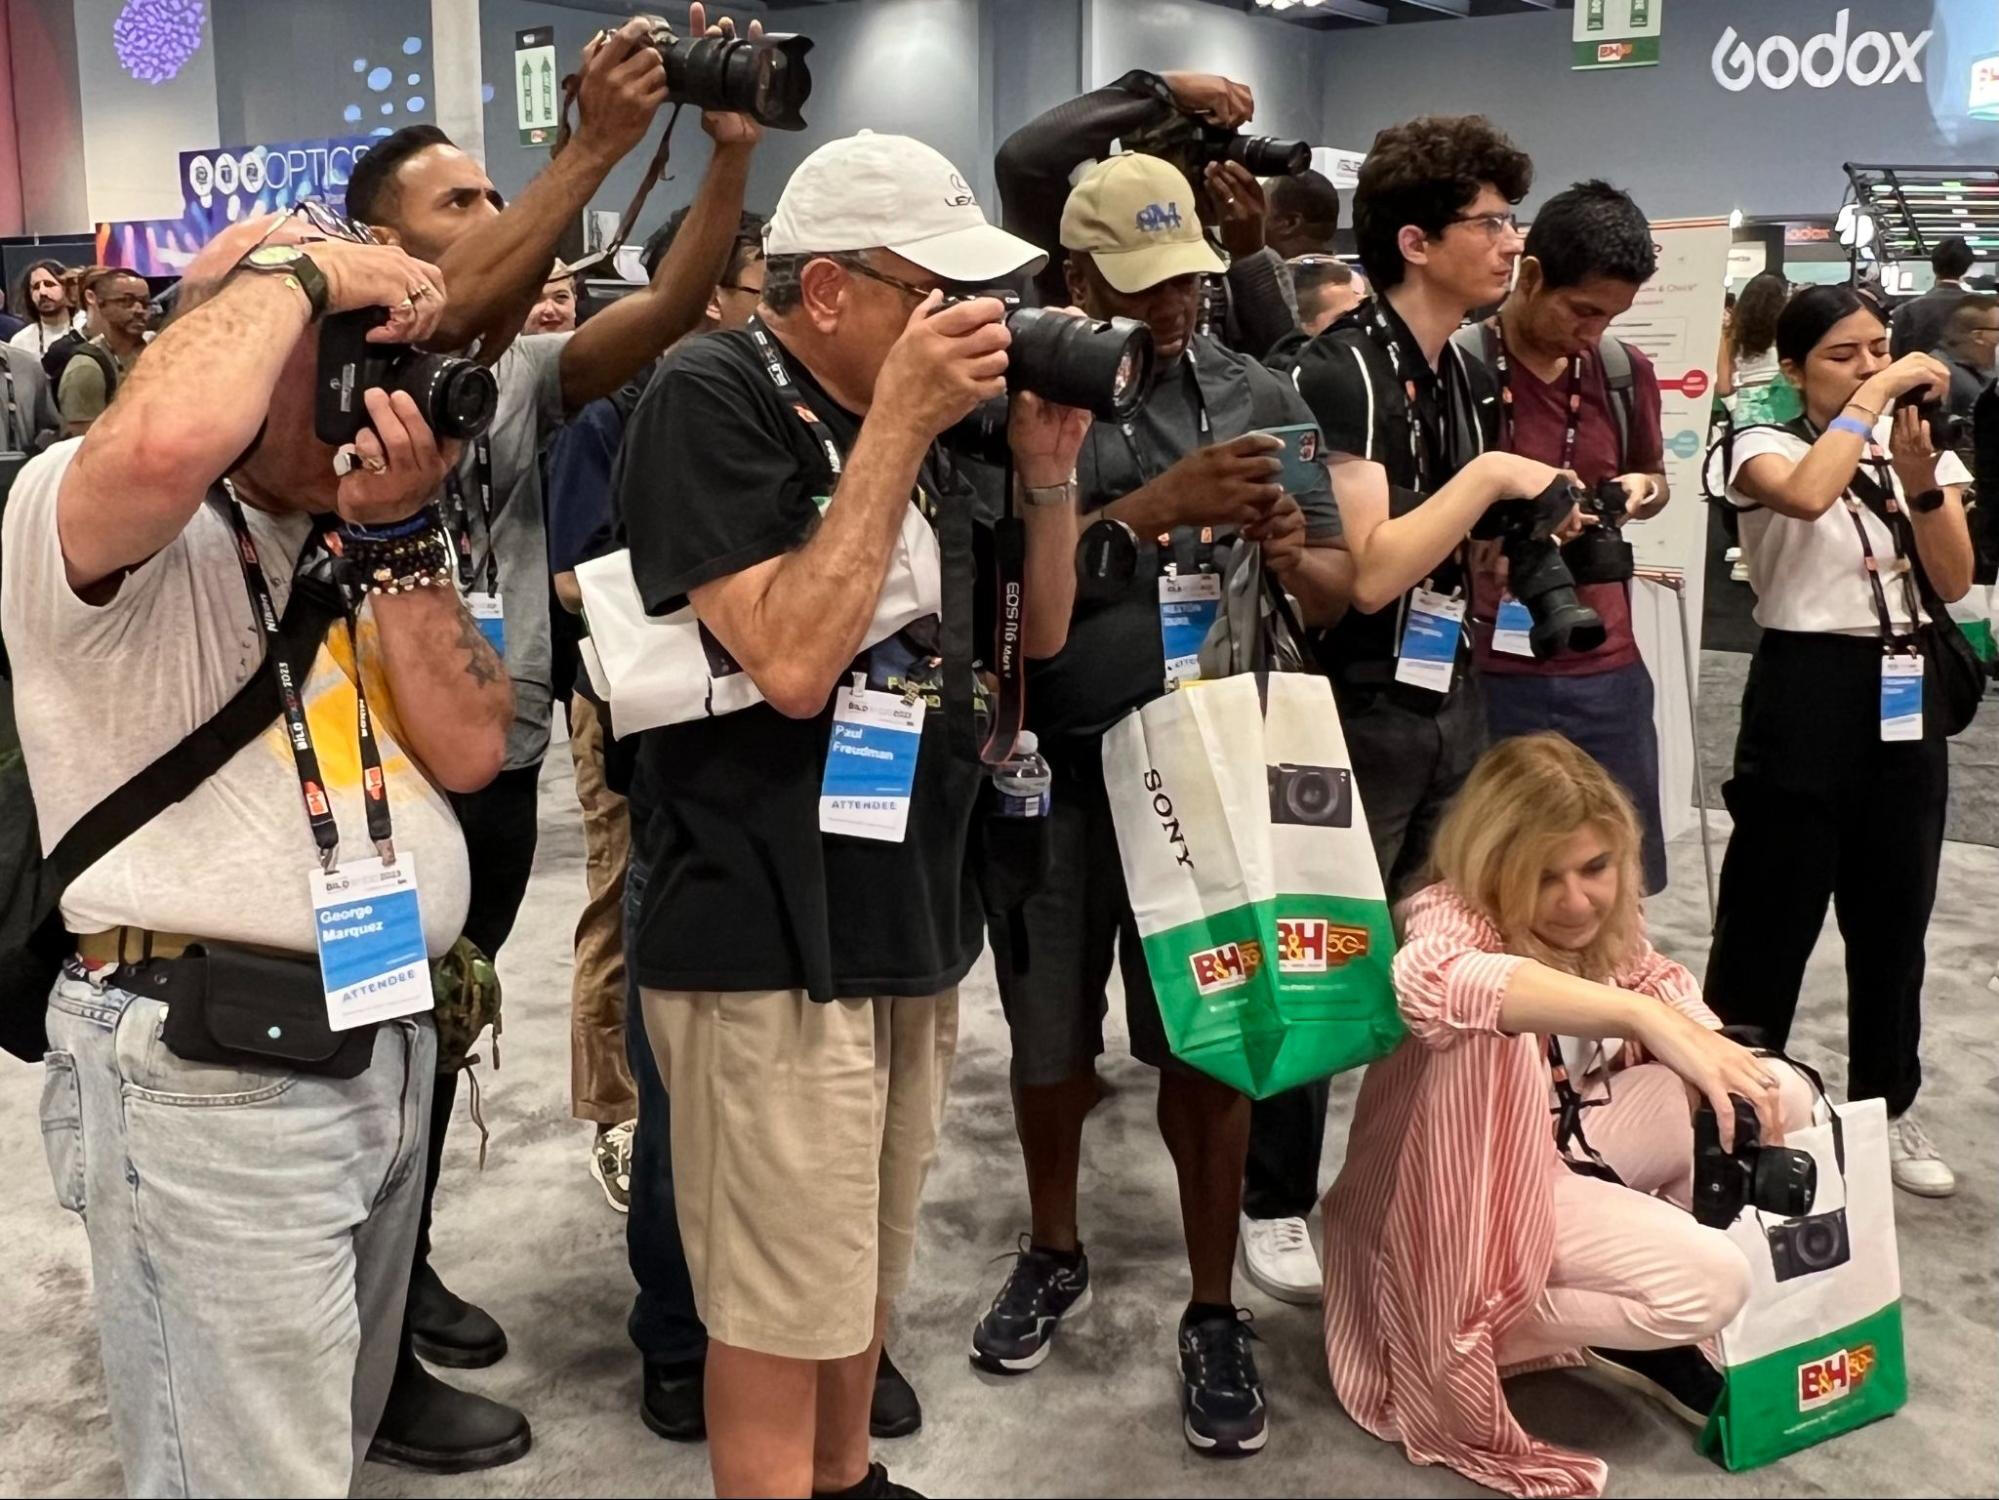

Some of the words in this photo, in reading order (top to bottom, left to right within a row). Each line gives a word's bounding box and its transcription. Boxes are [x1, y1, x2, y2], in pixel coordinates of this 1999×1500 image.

[944, 195, 980, 207] LEX
[1006, 582, 1020, 619] EOS
[835, 725, 863, 739] Paul
[831, 800, 897, 811] ATTENDEE
[1144, 769, 1194, 869] SONY
[320, 905, 374, 924] George
[322, 921, 384, 943] Marquez
[1278, 922, 1325, 961] B&H
[1193, 946, 1244, 986] B&H
[342, 969, 416, 1002] ATTENDEE
[1801, 1355, 1848, 1401] B&H
